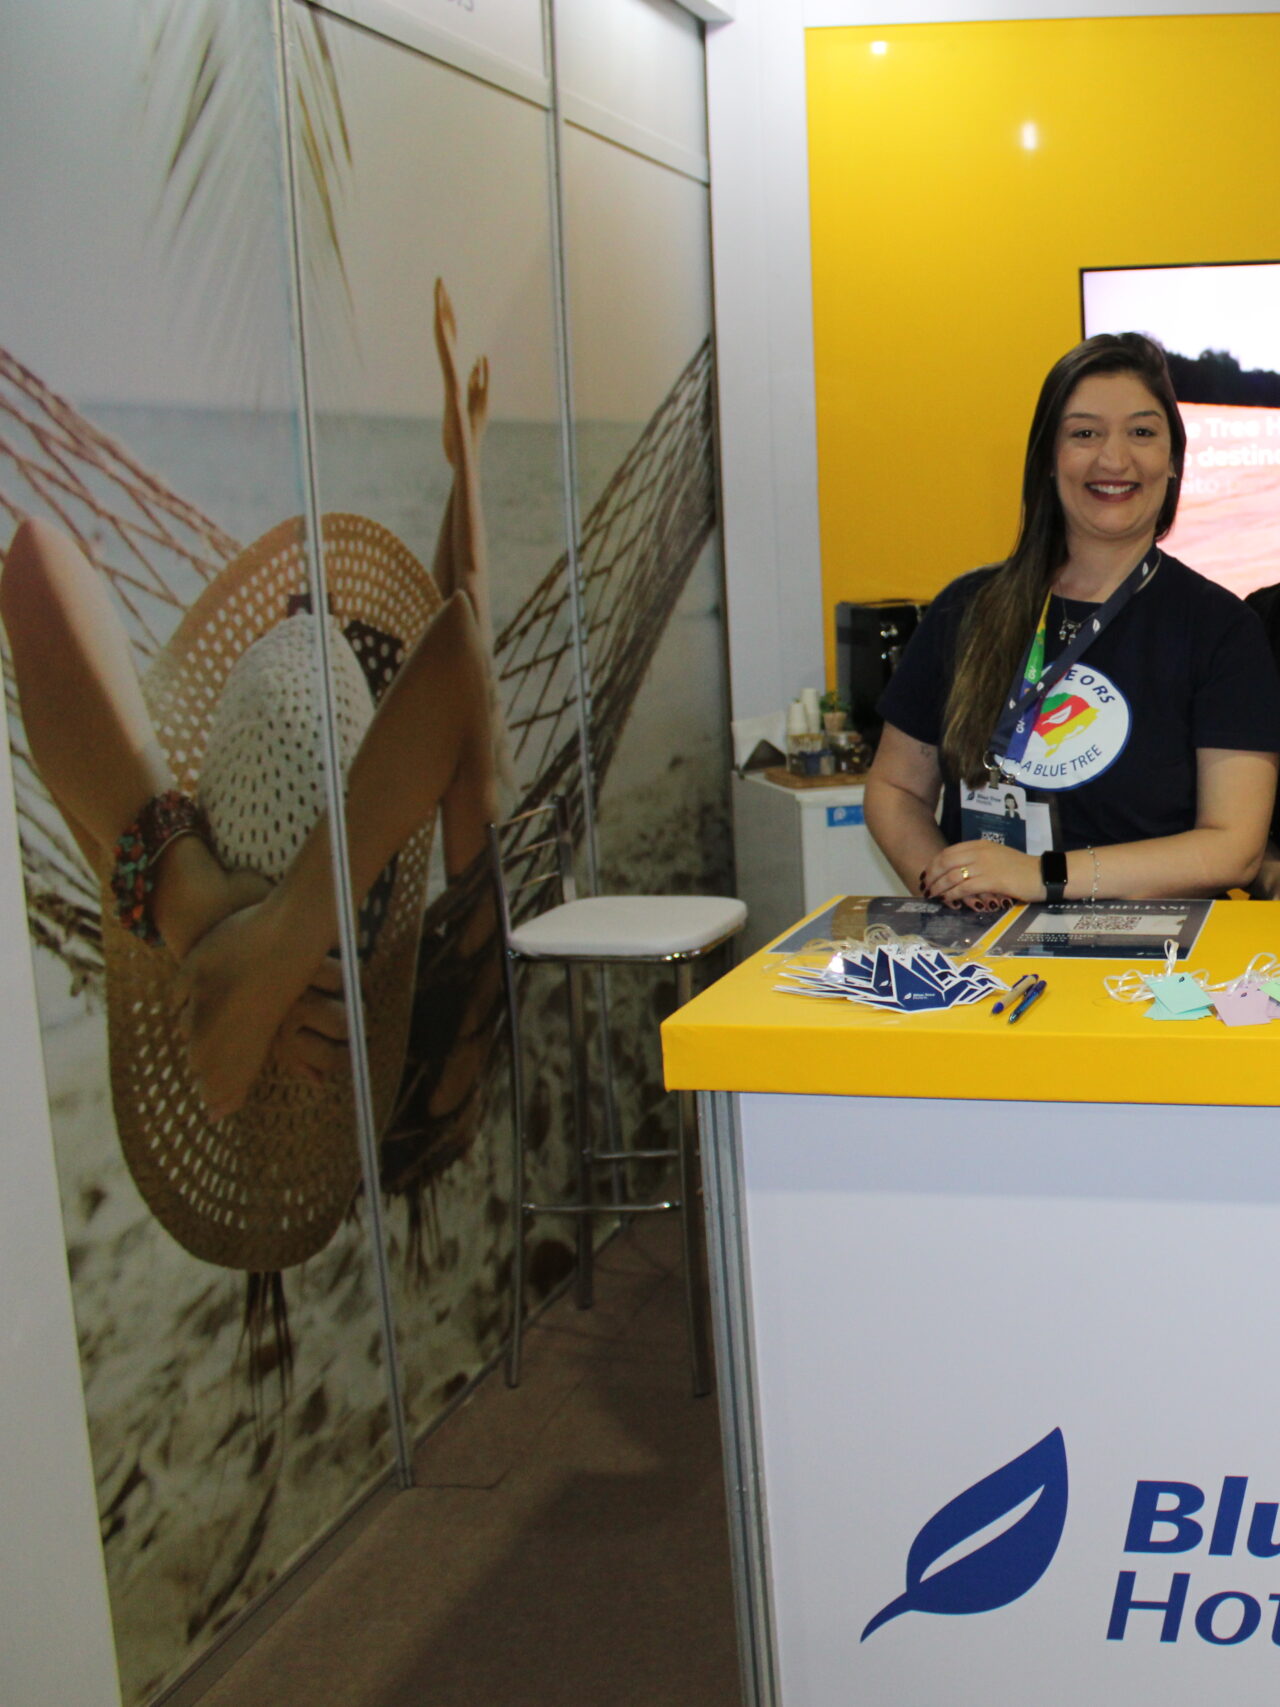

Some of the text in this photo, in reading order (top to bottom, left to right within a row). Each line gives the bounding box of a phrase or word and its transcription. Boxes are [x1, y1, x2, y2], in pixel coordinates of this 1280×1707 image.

[1204, 417, 1260, 439] Tree
[1033, 762, 1069, 777] BLUE
[1069, 744, 1102, 772] TREE
